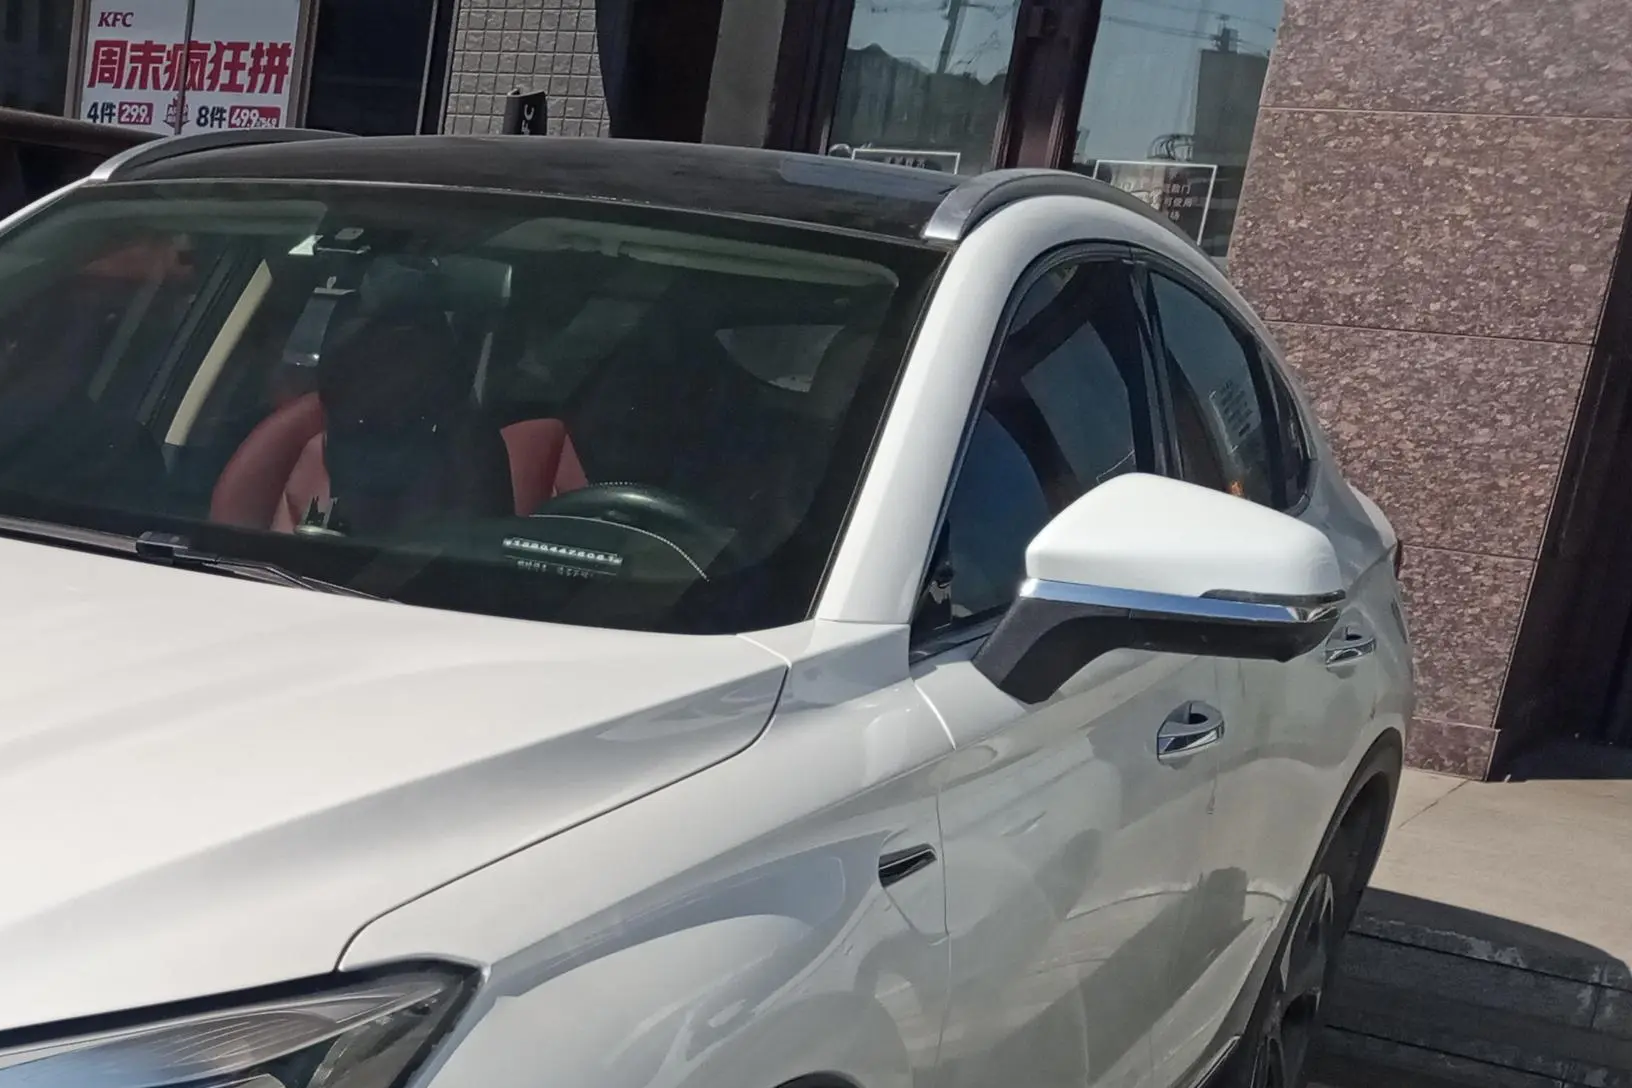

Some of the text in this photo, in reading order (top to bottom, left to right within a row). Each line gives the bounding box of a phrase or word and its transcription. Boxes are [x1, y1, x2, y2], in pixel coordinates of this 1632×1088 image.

[97, 11, 134, 28] KFC
[86, 39, 293, 94] 周末疯狂拼
[87, 101, 116, 124] 4件
[196, 106, 227, 129] 8件
